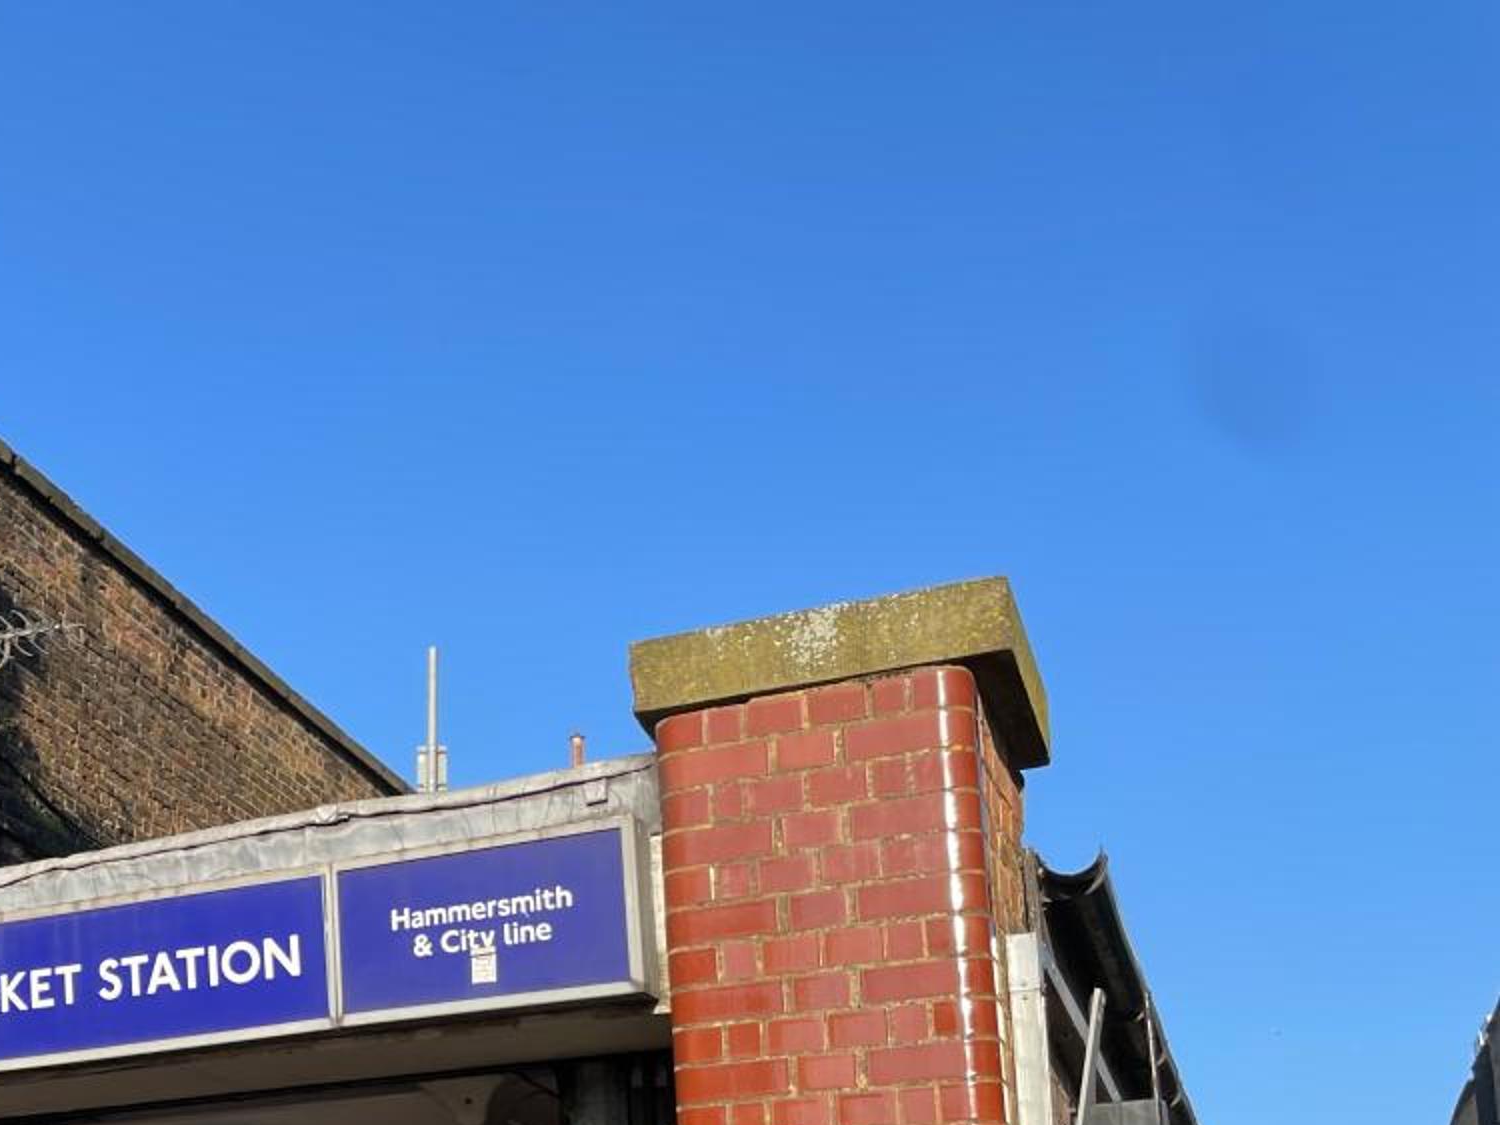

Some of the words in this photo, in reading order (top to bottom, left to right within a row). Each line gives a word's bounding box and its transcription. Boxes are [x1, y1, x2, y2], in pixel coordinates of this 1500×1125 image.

[390, 885, 573, 931] Hammersmith
[413, 934, 433, 957] &
[440, 928, 495, 953] City
[503, 922, 552, 946] line
[98, 933, 301, 1001] STATION
